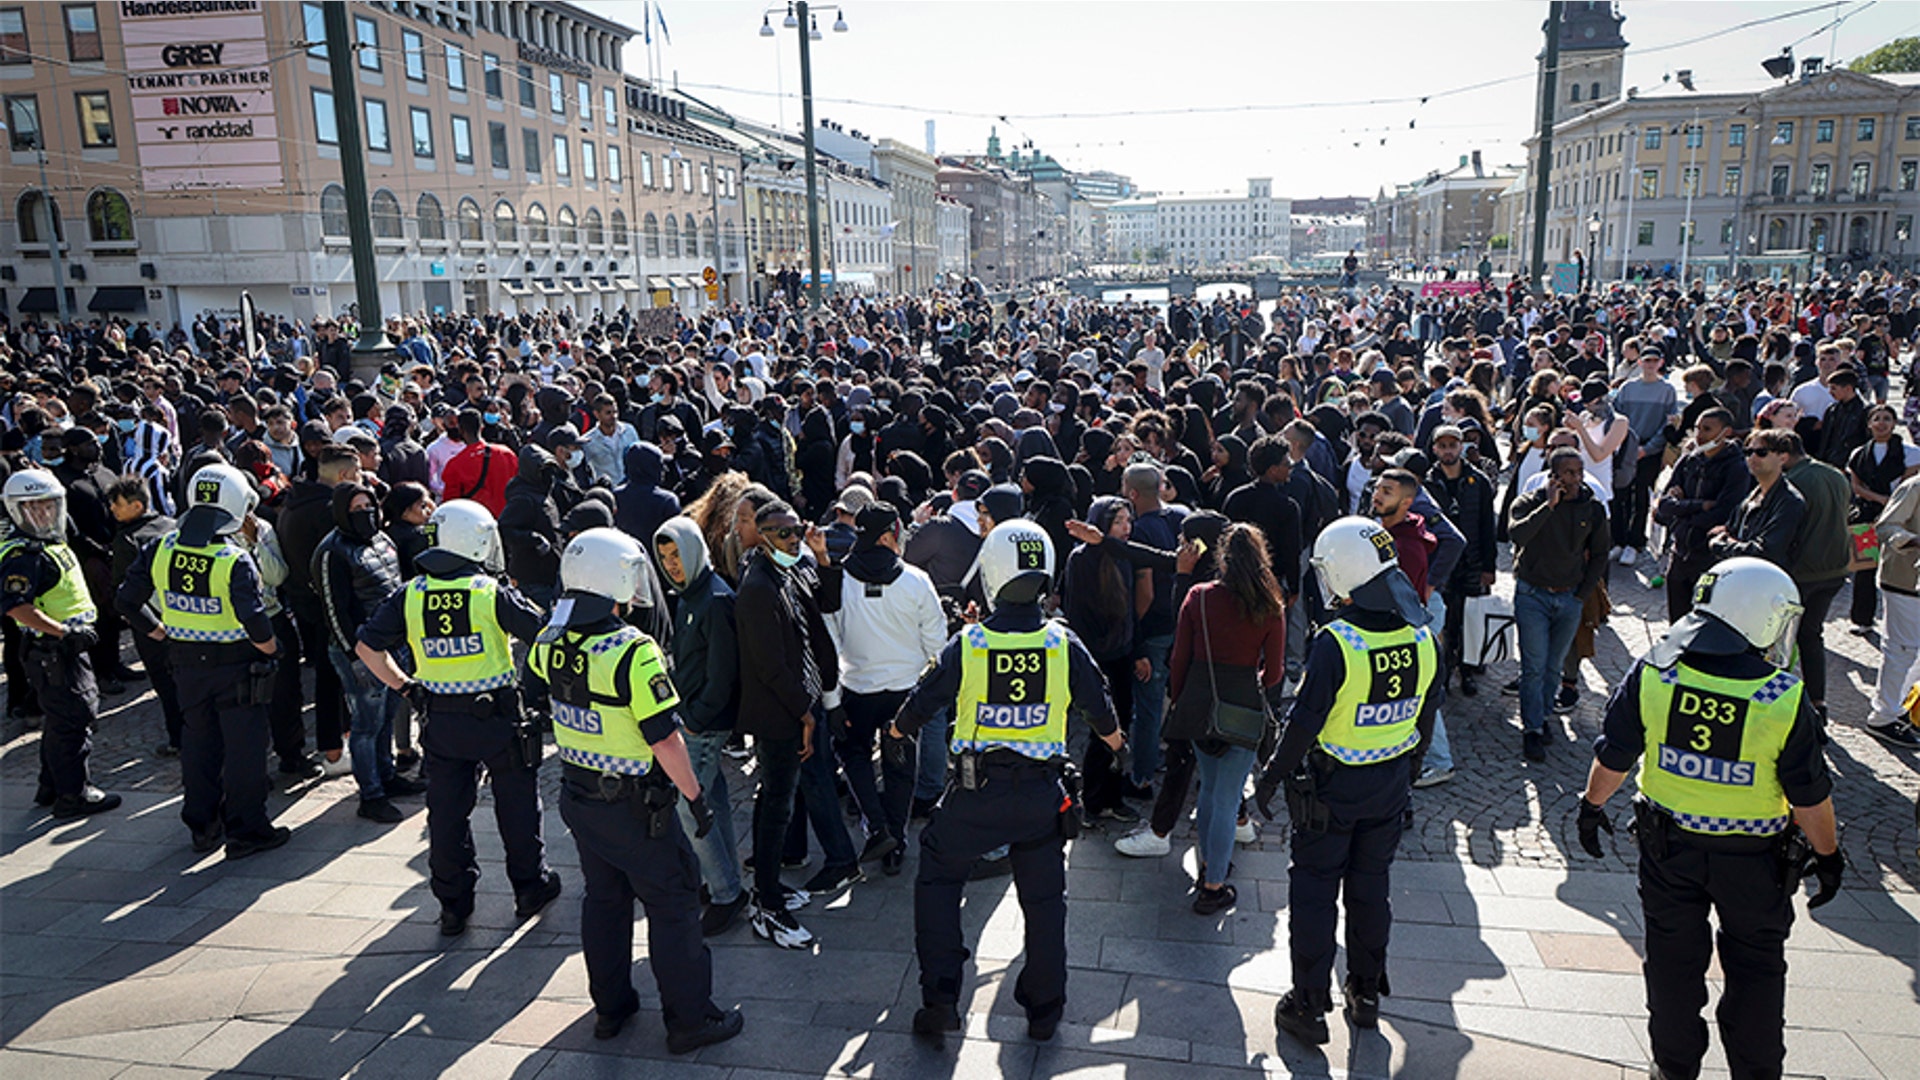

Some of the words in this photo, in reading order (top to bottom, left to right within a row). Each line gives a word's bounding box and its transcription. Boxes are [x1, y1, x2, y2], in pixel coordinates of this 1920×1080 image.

[122, 1, 257, 16] Handelsbanken
[162, 43, 224, 67] GREY
[128, 74, 184, 89] TENANT
[201, 72, 270, 86] PARTNER
[186, 120, 253, 139] randstad
[175, 554, 208, 573] D33
[1028, 554, 1038, 567] 3
[181, 574, 195, 593] 3
[166, 593, 220, 613] POLIS
[428, 593, 463, 611] D33
[439, 613, 453, 635] 3
[424, 635, 481, 656] POLIS
[995, 653, 1041, 673] D33
[1375, 648, 1413, 673] D33
[1009, 679, 1026, 702] 3
[1387, 674, 1401, 698] 3
[979, 705, 1047, 727] POLIS
[1357, 700, 1418, 725] POLIS
[1679, 692, 1736, 725] D33
[1690, 724, 1712, 751] 3
[1660, 747, 1752, 784] POLIS
